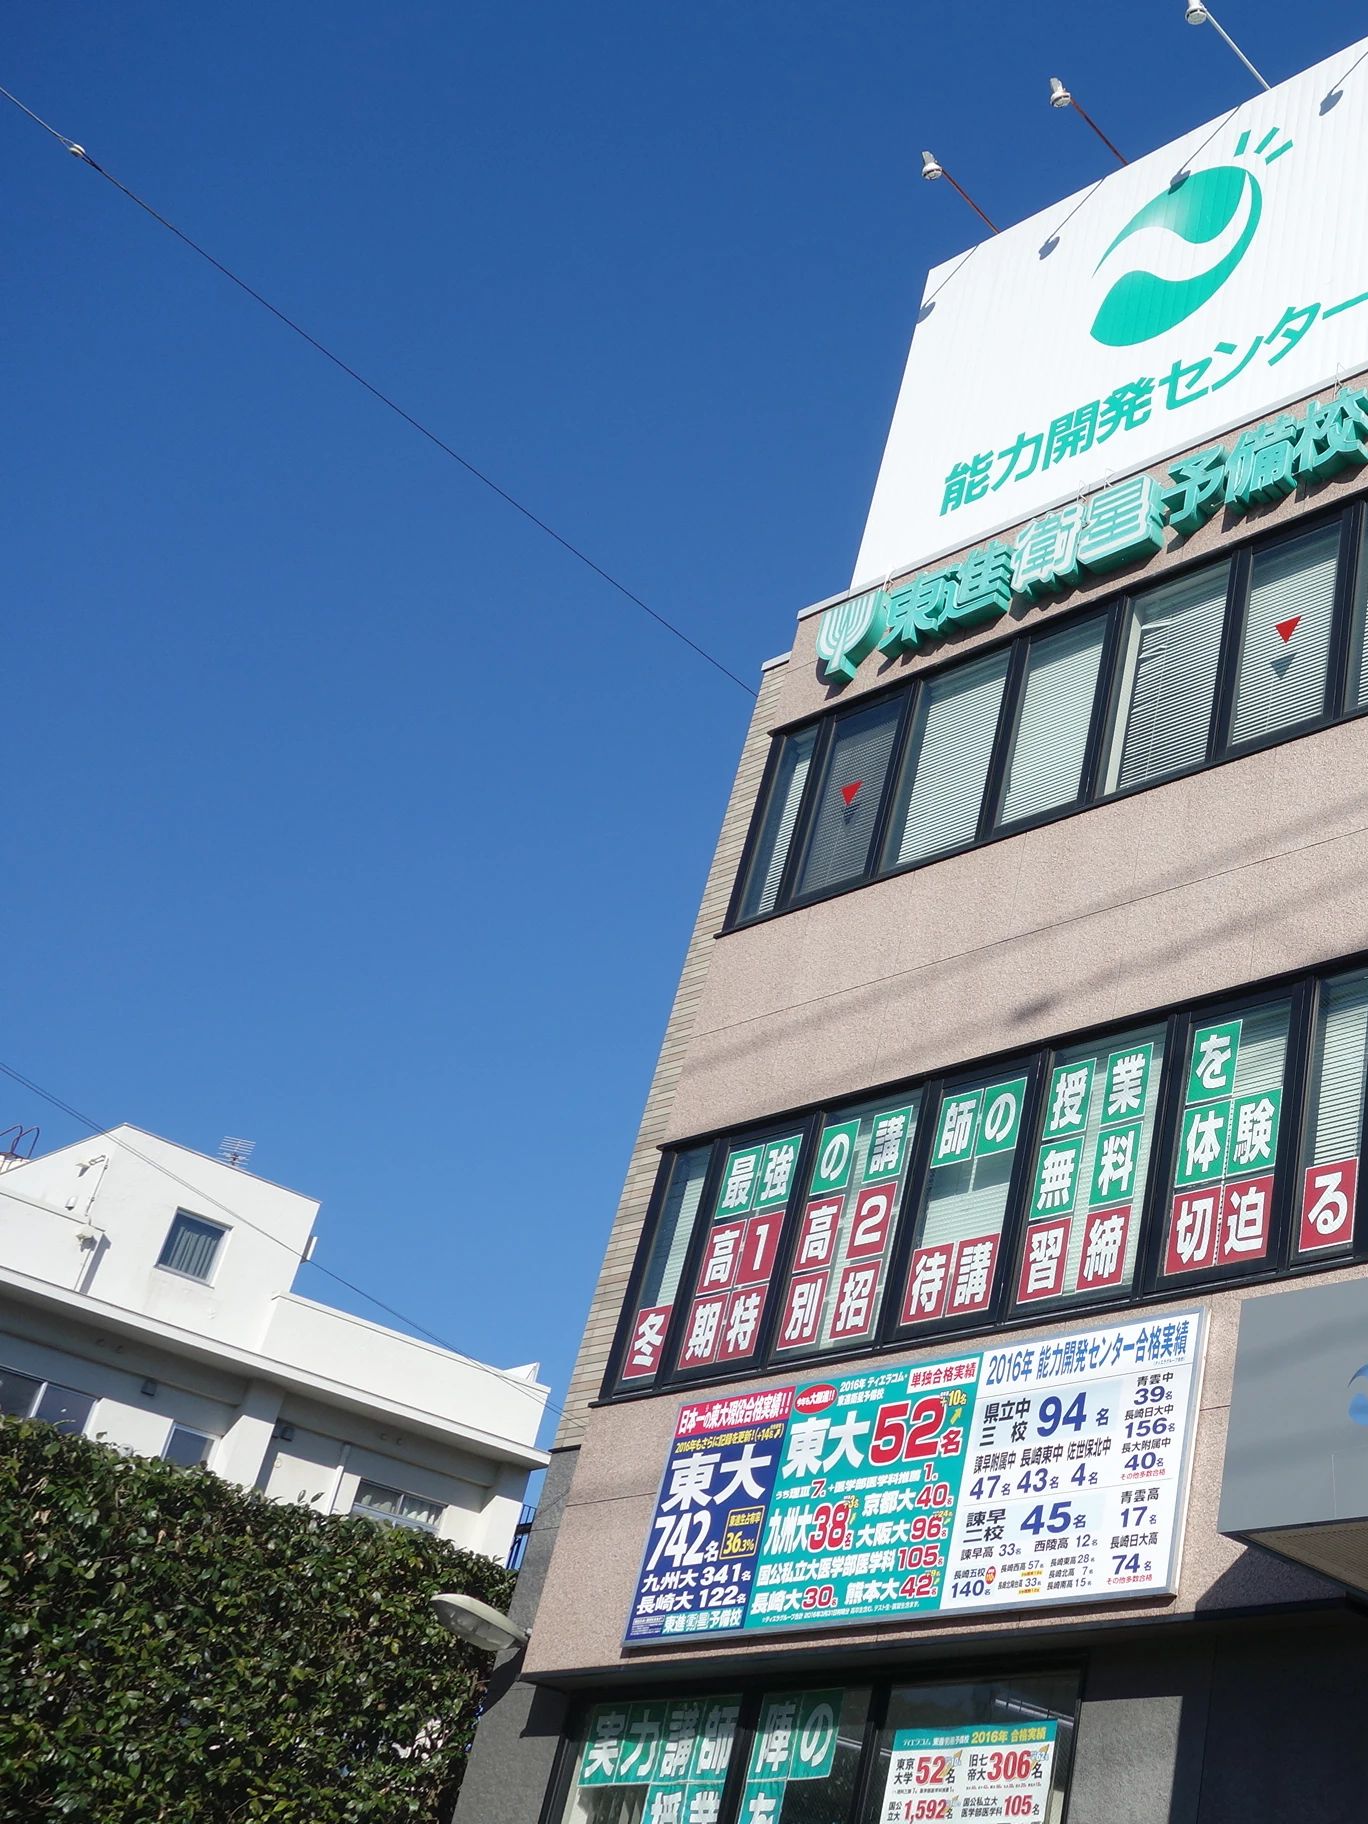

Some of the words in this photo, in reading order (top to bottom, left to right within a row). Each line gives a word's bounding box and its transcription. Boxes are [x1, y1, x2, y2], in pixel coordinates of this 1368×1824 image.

[1036, 1095, 1278, 1209] 無料体験
[985, 1348, 1035, 1386] 2016年
[1036, 1320, 1190, 1381] 能力開発センター合格実績
[910, 1361, 977, 1389] 単独合格実績
[1136, 1371, 1174, 1387] 青雲中
[983, 1397, 1031, 1425] 県立中
[1124, 1403, 1174, 1421] 長崎日大中
[1019, 1442, 1064, 1469] 長崎東中
[1066, 1435, 1112, 1461] 佐世保北中
[1121, 1437, 1172, 1454] 長大附属中
[660, 1443, 773, 1513] 東大
[1119, 1468, 1167, 1481] その他多数合格
[1119, 1486, 1160, 1505] 青雲高
[722, 1530, 755, 1555] 36.3%
[1109, 1531, 1159, 1550] 長崎日大高
[953, 1567, 986, 1580] 長崎五校
[1105, 1573, 1153, 1586] その他多数合格
[584, 1702, 834, 1779] 実力講師陣の
[971, 1730, 1009, 1745] 2016年
[1010, 1726, 1047, 1743] 合格実績
